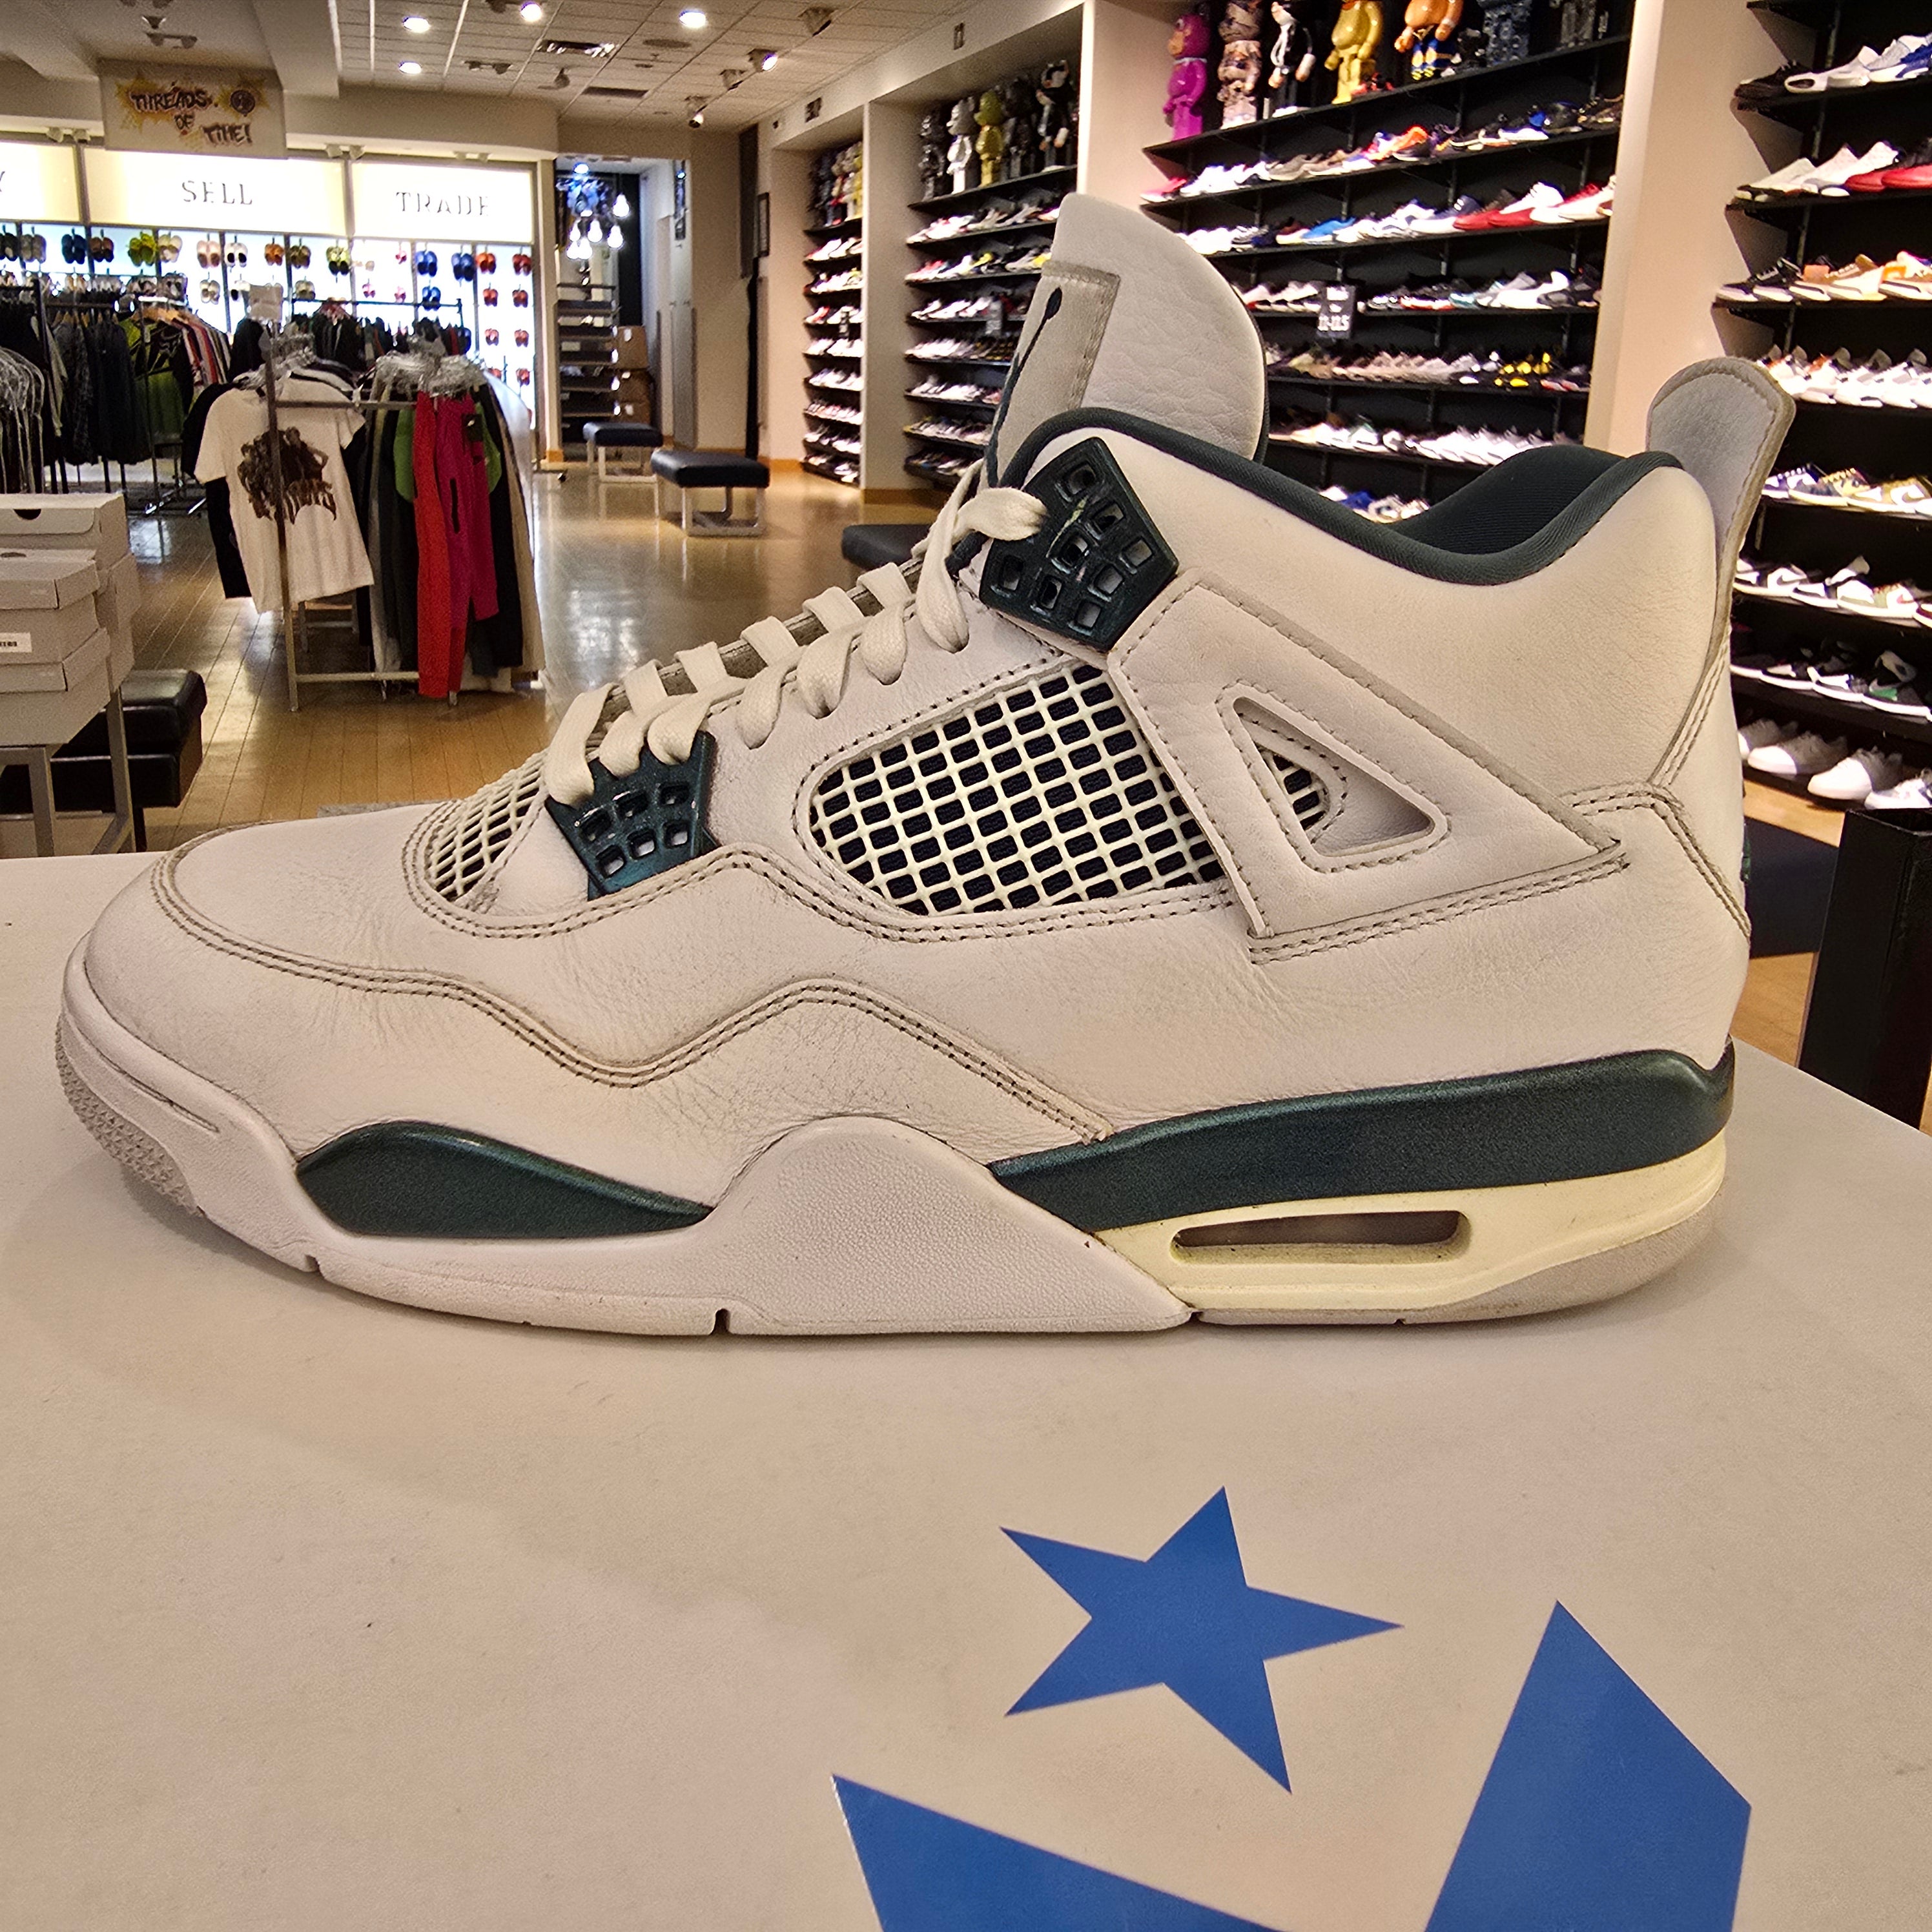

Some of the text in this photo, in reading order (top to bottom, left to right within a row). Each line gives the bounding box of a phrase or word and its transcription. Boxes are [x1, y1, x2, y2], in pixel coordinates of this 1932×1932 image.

[174, 114, 195, 130] OF
[181, 180, 252, 205] SELL
[396, 192, 488, 216] TRADE
